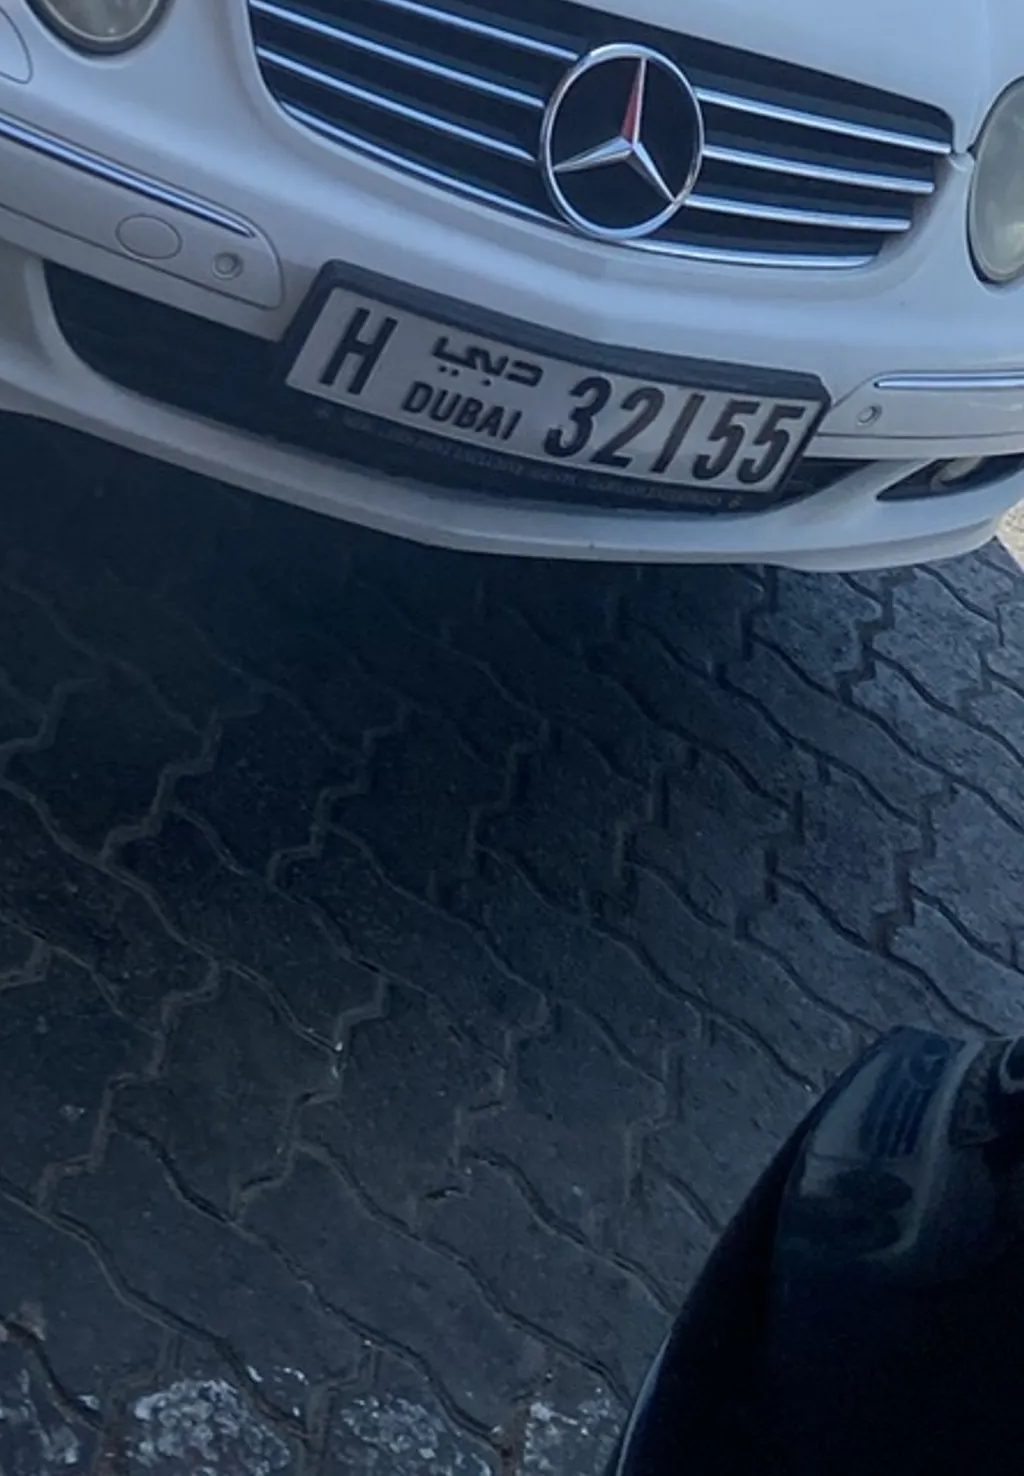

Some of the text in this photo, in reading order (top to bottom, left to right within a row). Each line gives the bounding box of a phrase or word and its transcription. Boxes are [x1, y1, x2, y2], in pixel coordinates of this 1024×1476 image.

[320, 308, 397, 395] H
[429, 335, 544, 388] دبي
[401, 380, 522, 441] DUBAI
[544, 376, 806, 484] 32155
